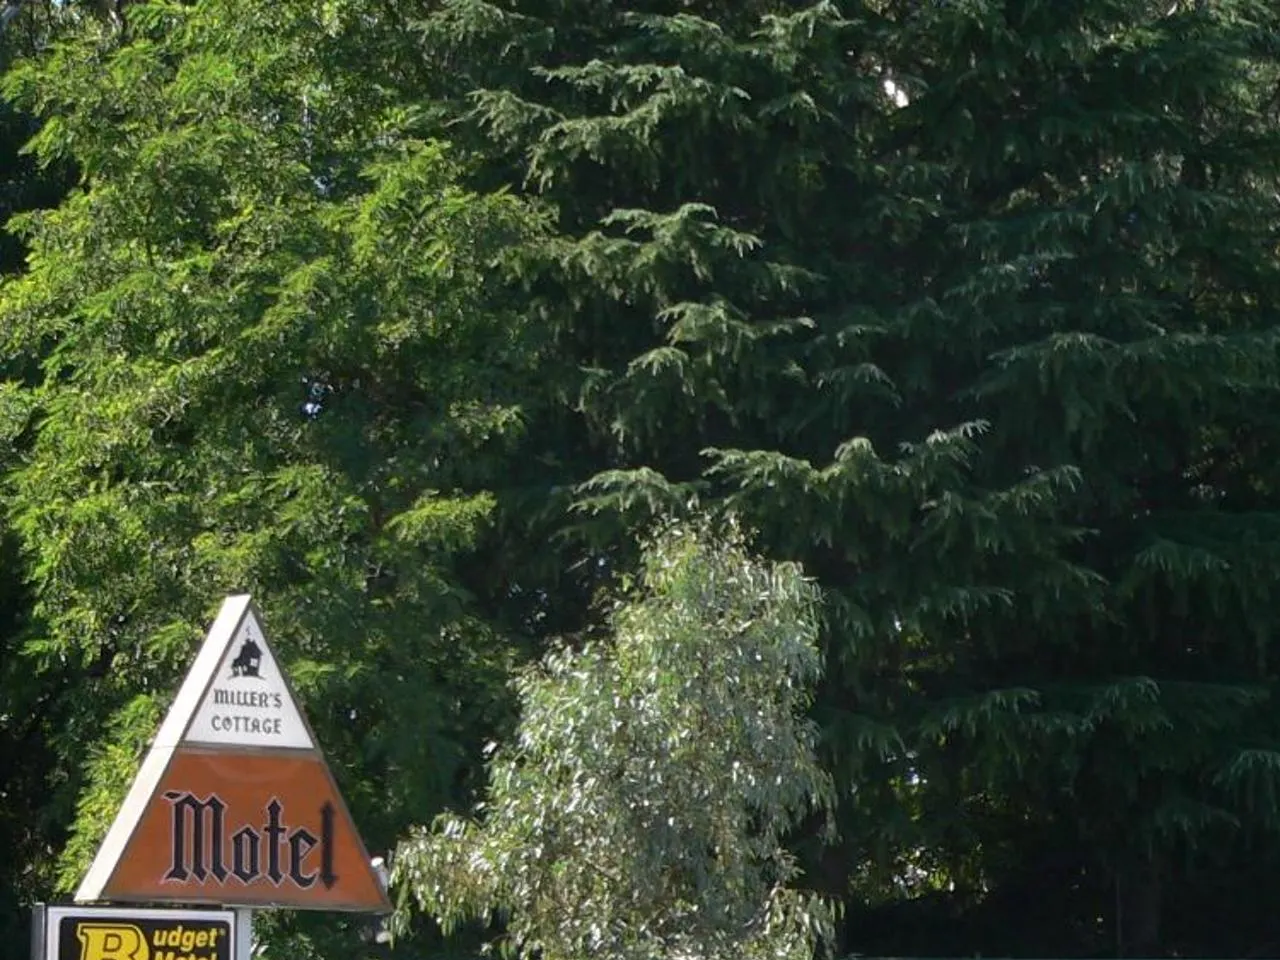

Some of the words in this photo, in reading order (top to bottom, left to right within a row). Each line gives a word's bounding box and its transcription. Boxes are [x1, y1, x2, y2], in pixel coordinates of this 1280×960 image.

[214, 688, 283, 709] MILLER'S
[211, 715, 282, 735] COTTAGE
[161, 791, 338, 891] Motel
